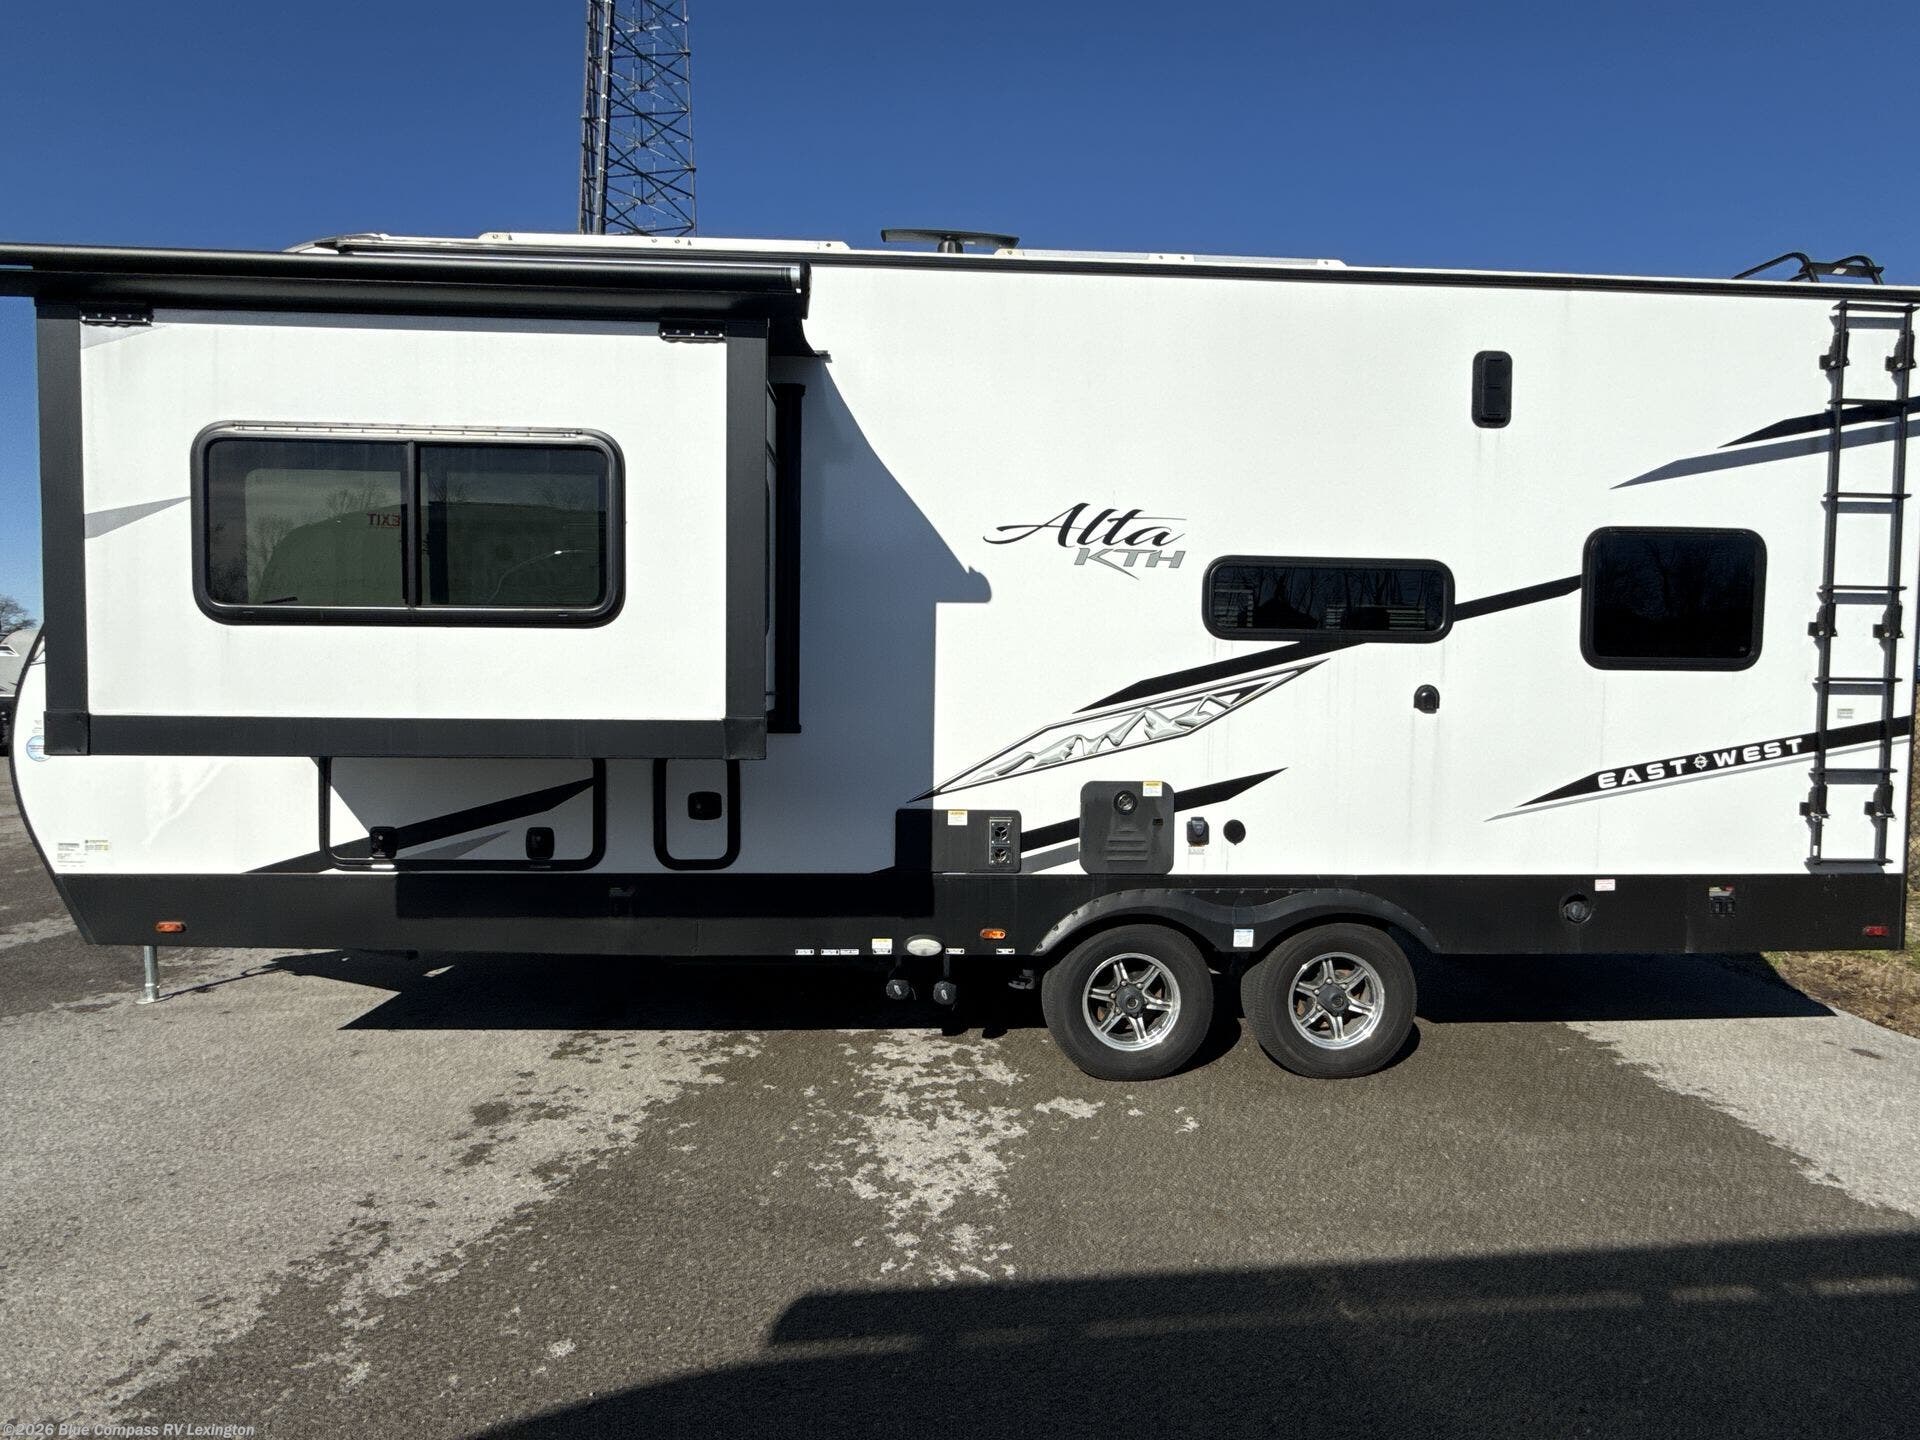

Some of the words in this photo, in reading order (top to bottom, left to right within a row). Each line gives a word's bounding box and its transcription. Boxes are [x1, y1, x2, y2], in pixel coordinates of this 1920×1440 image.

[983, 502, 1187, 548] Alta
[1074, 548, 1186, 581] KTH
[1597, 759, 1688, 789] EAST
[1712, 738, 1803, 768] WEST
